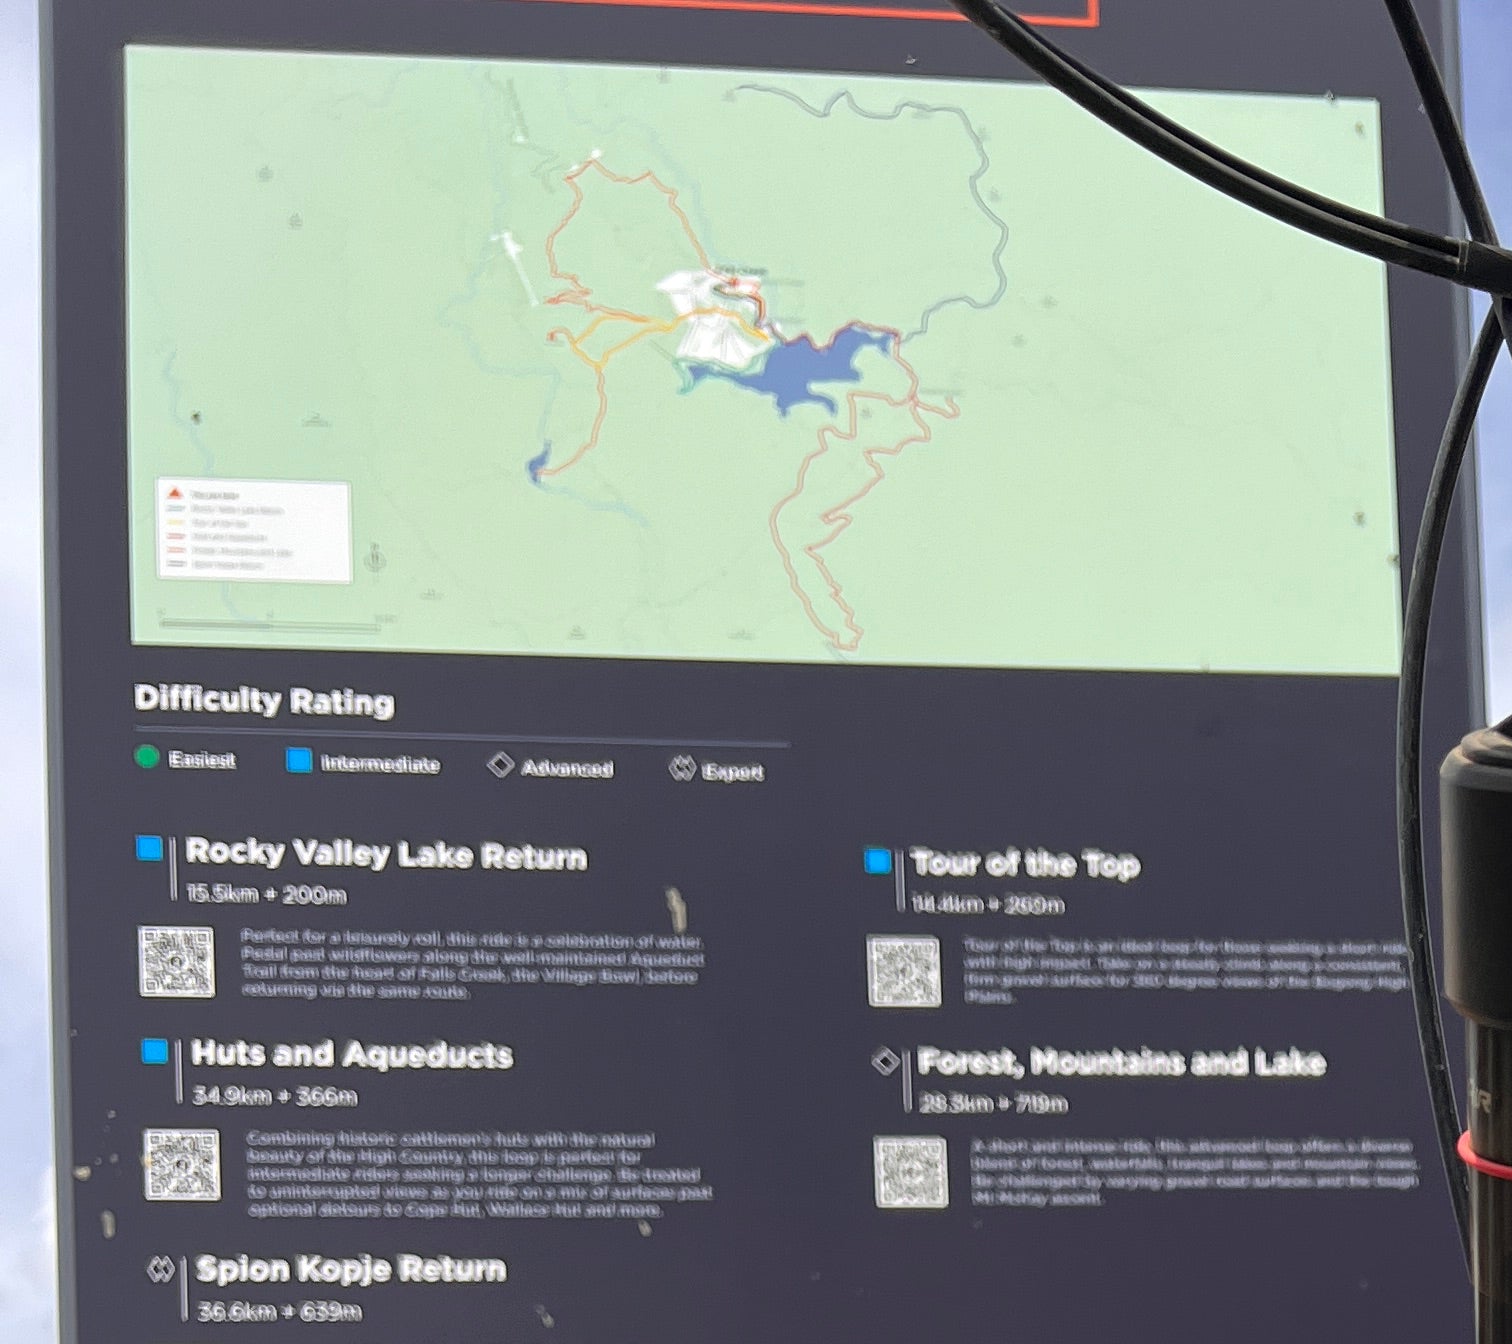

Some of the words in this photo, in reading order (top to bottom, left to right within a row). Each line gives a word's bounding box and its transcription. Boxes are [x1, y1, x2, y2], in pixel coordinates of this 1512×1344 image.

[134, 683, 282, 718] Difficulty
[290, 687, 395, 721] Rating
[168, 750, 237, 769] Easiest
[321, 754, 442, 775] Intermediate
[521, 759, 615, 779] Advanced
[701, 762, 766, 784] Expert
[185, 836, 286, 869] Rocky
[292, 838, 391, 872] Valley
[398, 840, 474, 869] Lake
[480, 841, 589, 871] Return
[910, 845, 981, 877] Tour
[985, 846, 1021, 877] of
[1024, 846, 1078, 878] the
[1081, 847, 1142, 883] Top
[186, 883, 260, 903] 15.5km
[282, 884, 348, 906] 200m
[191, 1039, 266, 1067] Huts
[272, 1039, 334, 1068] and
[341, 1040, 514, 1072] Aqueducts
[916, 1045, 1026, 1080] Forest,
[1030, 1046, 1187, 1076] Mountains
[1190, 1046, 1249, 1076] and
[1254, 1046, 1328, 1076] Lake
[191, 1084, 273, 1107] 34.9km
[295, 1085, 358, 1107] 366m
[195, 1253, 291, 1287] Spion
[295, 1253, 393, 1287] Kopje
[396, 1253, 507, 1282] Return
[197, 1301, 278, 1323] 36.6km
[300, 1301, 363, 1323] 639m
